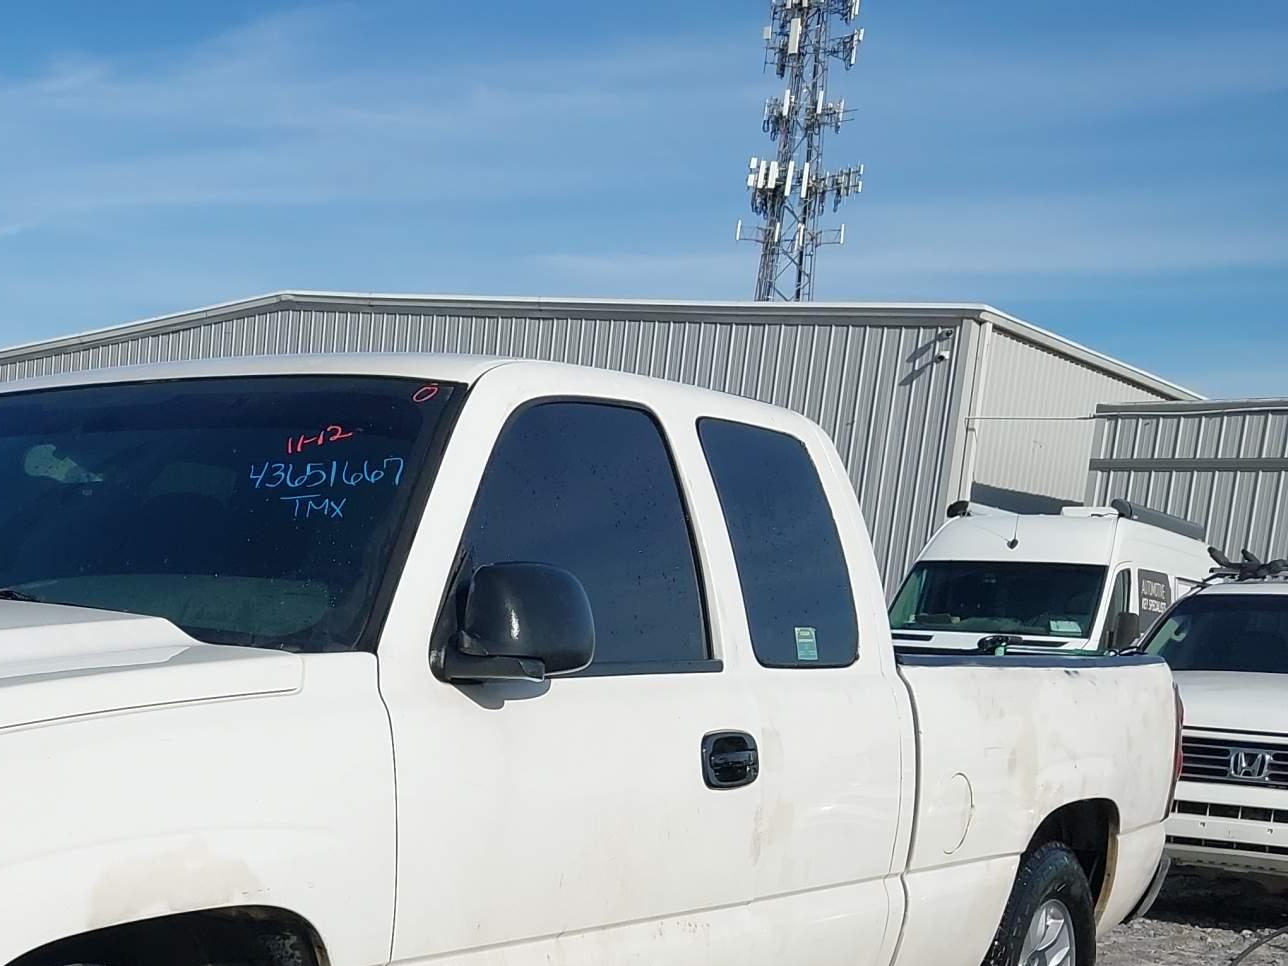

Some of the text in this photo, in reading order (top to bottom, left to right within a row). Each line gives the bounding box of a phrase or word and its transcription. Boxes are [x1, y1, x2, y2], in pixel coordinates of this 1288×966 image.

[286, 425, 353, 454] 11-12
[249, 457, 405, 489] 43651667
[279, 494, 347, 519] TMX
